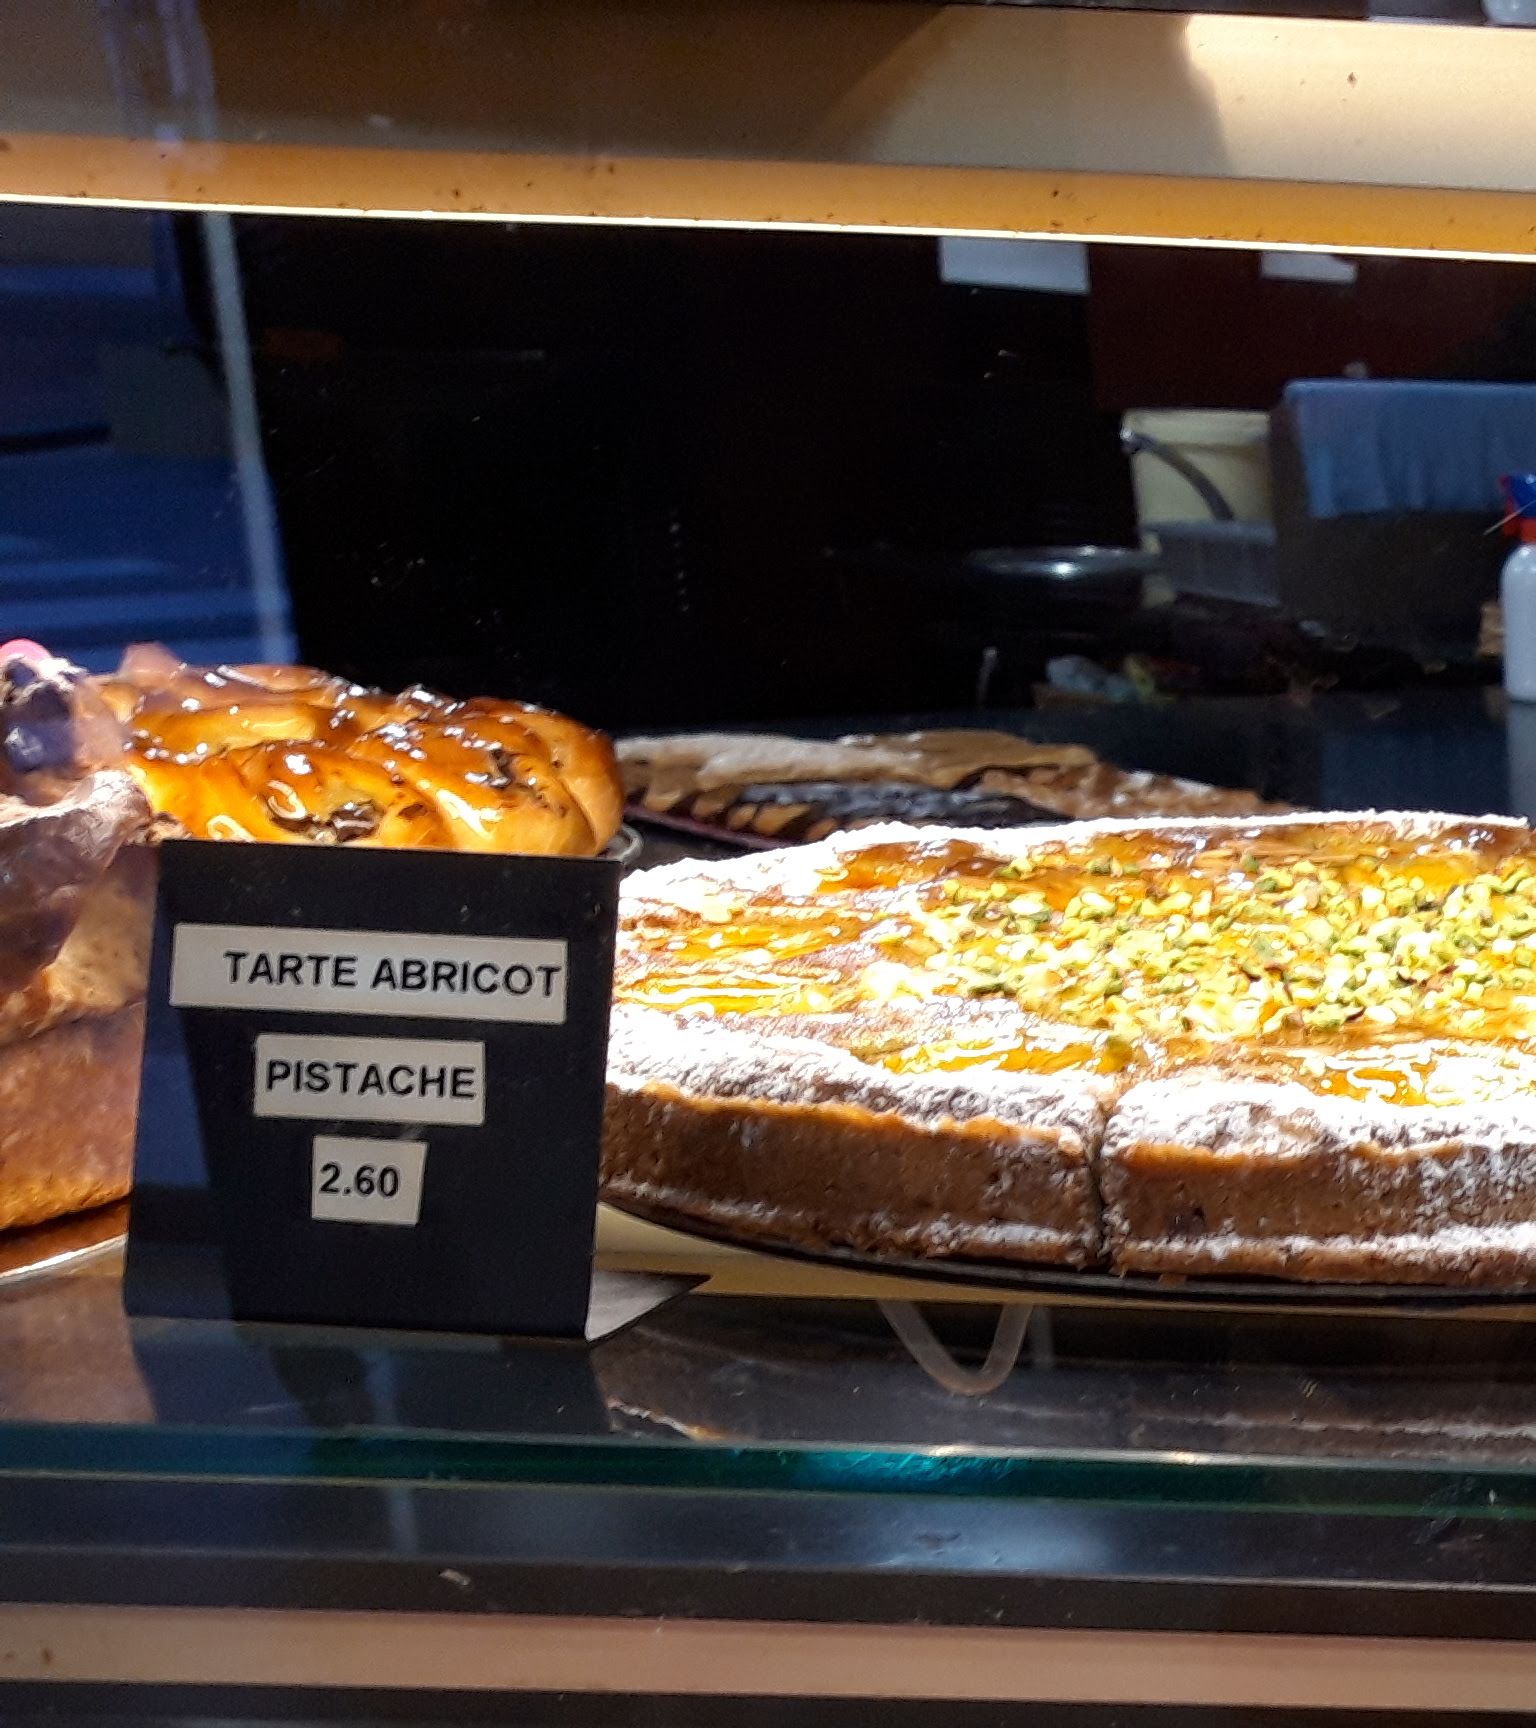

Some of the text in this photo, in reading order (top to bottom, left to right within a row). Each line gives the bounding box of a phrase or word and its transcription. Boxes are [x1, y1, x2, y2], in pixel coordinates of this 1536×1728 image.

[223, 950, 563, 998] TARTE ABRICOT
[265, 1058, 477, 1099] PISTACHE
[318, 1162, 400, 1199] 2.60
